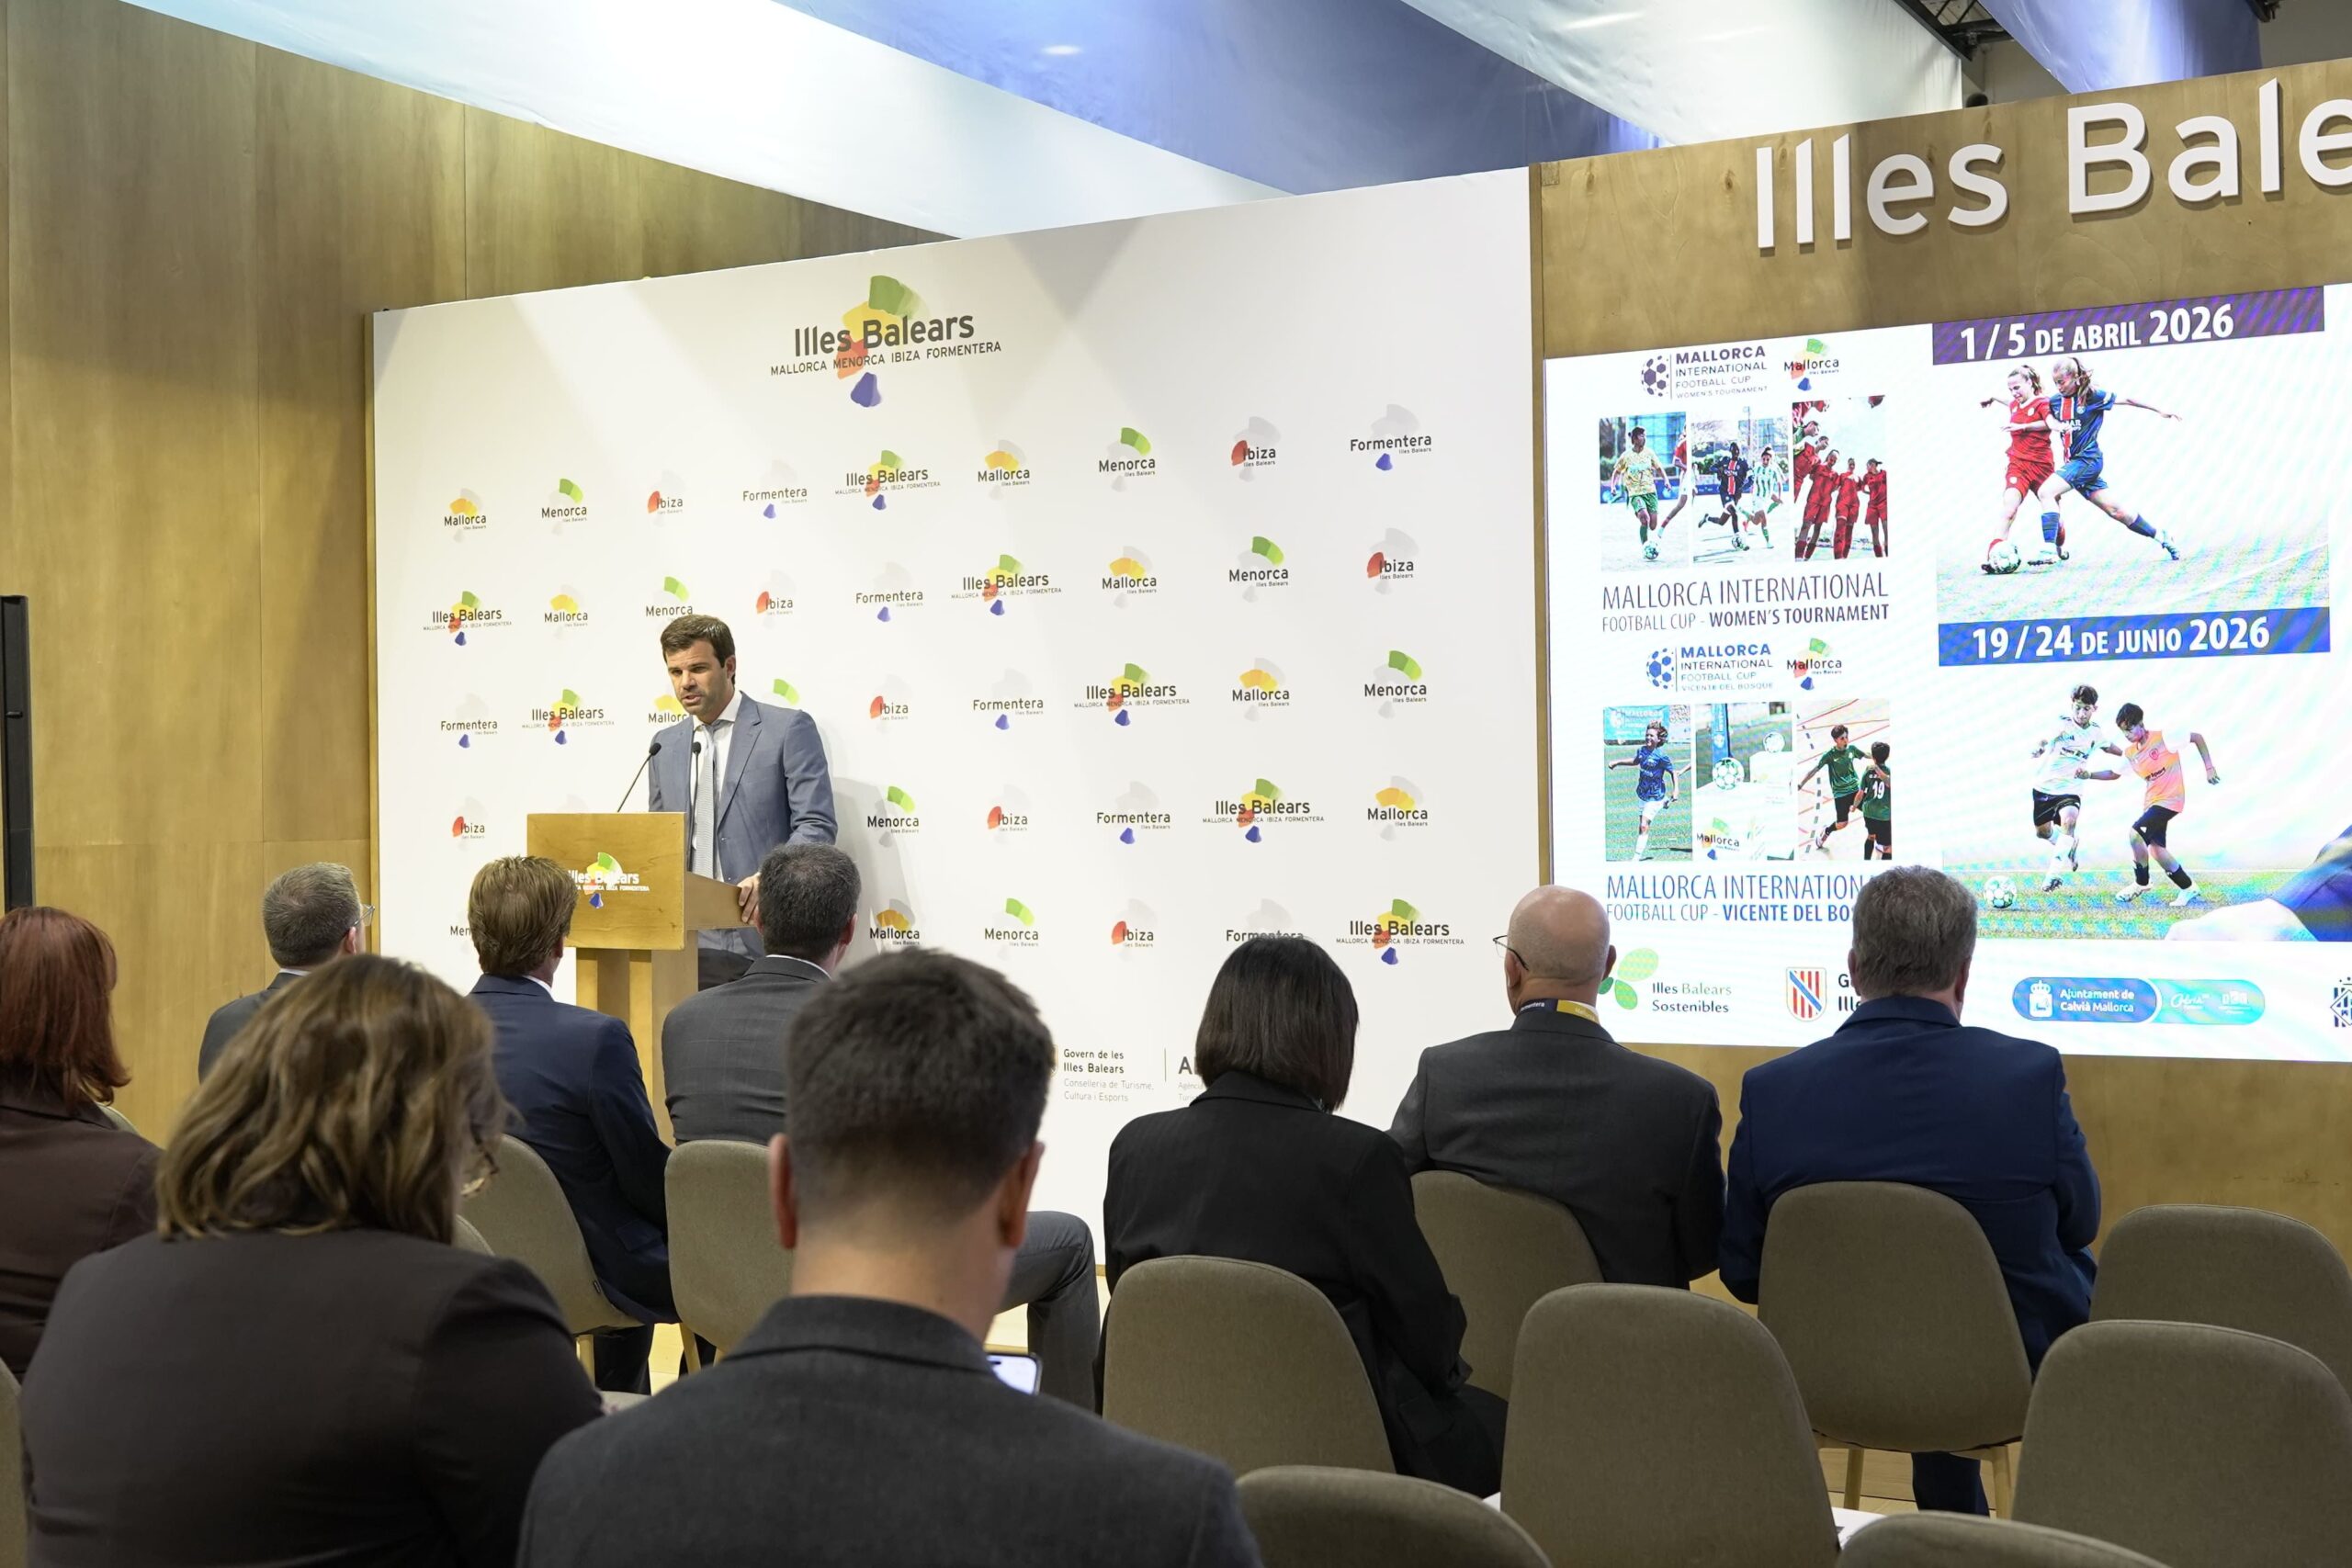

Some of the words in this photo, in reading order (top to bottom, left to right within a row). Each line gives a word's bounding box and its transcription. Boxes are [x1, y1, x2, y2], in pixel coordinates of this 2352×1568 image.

[1756, 132, 2009, 249] Illes
[795, 325, 851, 356] Illes
[863, 314, 975, 349] Balears
[2035, 332, 2064, 354] DE
[2072, 321, 2141, 351] ABRIL
[2149, 303, 2234, 344] 2026
[771, 361, 827, 376] MALLORCA
[833, 354, 885, 368] MENORCA
[891, 351, 920, 363] IBIZA
[926, 342, 1001, 359] FORMENTERA
[1676, 345, 1766, 364] MALLORCA
[1676, 361, 1768, 377] INTERNATIONAL
[1784, 358, 1839, 372] Mallorca
[1676, 378, 1726, 389] FOOTBALL
[1731, 376, 1751, 384] CUP
[1351, 434, 1431, 451] Formentera
[1243, 447, 1276, 460] Ibiza
[1099, 458, 1155, 473] Menorca
[846, 472, 872, 486] Illes
[877, 468, 928, 483] Balears
[978, 468, 1030, 482] Mallorca
[742, 486, 808, 502] Formentera
[656, 497, 683, 509] Ibiza
[541, 506, 587, 518] Menorca
[445, 514, 486, 526] Mallorca
[1379, 559, 1414, 573] Ibiza
[1229, 568, 1288, 581] Menorca
[963, 577, 990, 591] Illes
[996, 574, 1048, 588] Balears
[1102, 576, 1157, 589] Mallorca
[855, 590, 922, 604] Formentera
[1602, 581, 1712, 611] MALLORCA
[1720, 572, 1889, 605] INTERNATIONAL
[646, 604, 693, 617] Menorca
[765, 598, 793, 610] Ibiza
[433, 611, 455, 623] Illes
[459, 609, 502, 621] Balears
[545, 610, 588, 622] Mallorca
[1601, 615, 1667, 632] FOOTBALL
[1670, 614, 1696, 628] CUP
[1709, 607, 1781, 627] WOMEN'S
[1784, 604, 1889, 625] TOURNAMENT
[1973, 627, 2010, 659] 19
[2036, 626, 2074, 656] 24
[2082, 631, 2109, 655] DE
[2115, 628, 2182, 654] JUNIO
[2189, 616, 2270, 650] 2026
[1680, 644, 1771, 658] MALLORCA
[1680, 660, 1773, 670] INTERNATIONAL
[1787, 659, 1842, 671] Mallorca
[1681, 672, 1732, 682] FOOTBALL
[1736, 671, 1756, 680] CUP
[1086, 685, 1115, 700] Illes
[1121, 683, 1177, 699] Balears
[1232, 689, 1290, 702] Mallorca
[1364, 682, 1427, 696] Menorca
[879, 703, 909, 715] Ibiza
[973, 698, 1044, 711] Formentera
[532, 708, 555, 721] Illes
[560, 706, 604, 719] Balears
[648, 712, 687, 723] Mallorc
[440, 719, 497, 731] Formentera
[1871, 781, 1885, 799] 19
[1216, 801, 1246, 815] Illes
[1251, 800, 1310, 814] Balears
[1367, 808, 1428, 820] Mallorca
[867, 816, 919, 829] Menorca
[998, 813, 1028, 826] Ibiza
[1097, 812, 1170, 824] Formentera
[460, 823, 485, 833] Ibiza
[1696, 833, 1740, 847] Mallorca
[567, 870, 591, 883] lles
[1607, 874, 1716, 900] MALLORCA
[1724, 875, 1864, 899] INTERNATION
[1606, 904, 1676, 921] FOOTBALL
[1680, 904, 1708, 921] CUP
[1723, 904, 1788, 921] VICENTE
[1793, 904, 1823, 921] DEL
[869, 927, 920, 941] Mallorca
[985, 928, 1038, 941] Menorca
[1350, 921, 1383, 936] Illes
[1388, 920, 1450, 936] Balears
[1122, 930, 1154, 942] Ibiza
[1652, 982, 1678, 995] Illes
[1681, 982, 1732, 996] Balears
[2060, 988, 2121, 1000] Ajuntament
[2123, 989, 2134, 999] de
[1652, 999, 1729, 1013] Sostenibles
[2060, 1000, 2091, 1011] Calvià
[2093, 1001, 2134, 1012] Mallorca
[1064, 1049, 1094, 1058] Govern
[1098, 1050, 1108, 1059] de
[1112, 1050, 1124, 1059] les
[1064, 1063, 1083, 1072] Illes
[1088, 1063, 1125, 1074] Balears
[1064, 1078, 1106, 1089] Conselleria
[1109, 1079, 1118, 1089] de
[1064, 1091, 1091, 1100] Cultura
[1099, 1092, 1128, 1102] Esports
